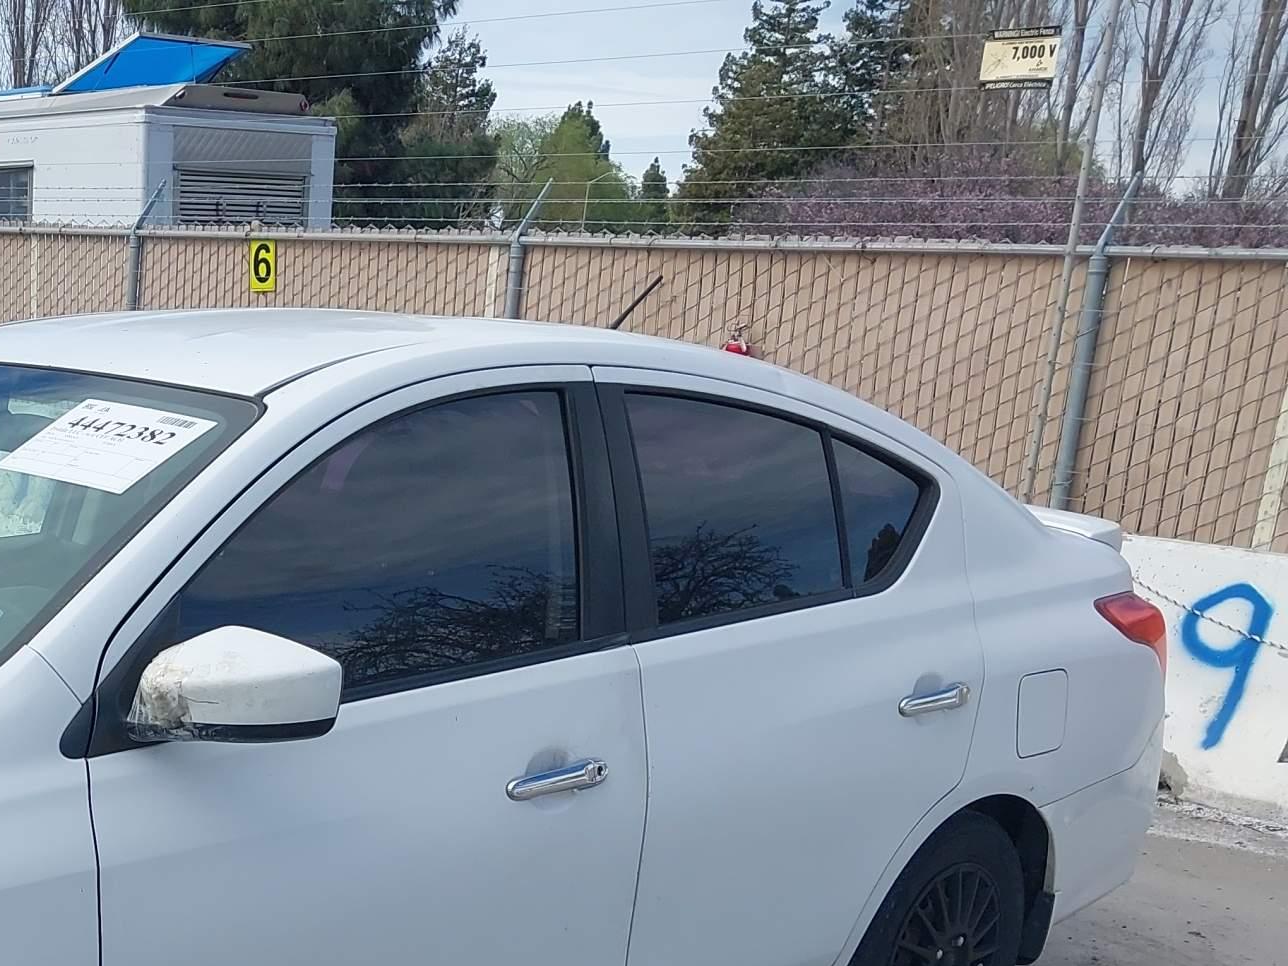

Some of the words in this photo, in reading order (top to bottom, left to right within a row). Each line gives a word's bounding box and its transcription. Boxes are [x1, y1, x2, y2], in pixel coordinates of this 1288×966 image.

[1012, 44, 1046, 61] 7,000
[1049, 44, 1057, 58] V
[253, 243, 272, 284] 6
[67, 416, 177, 445] 44472382
[1180, 582, 1274, 751] 9
